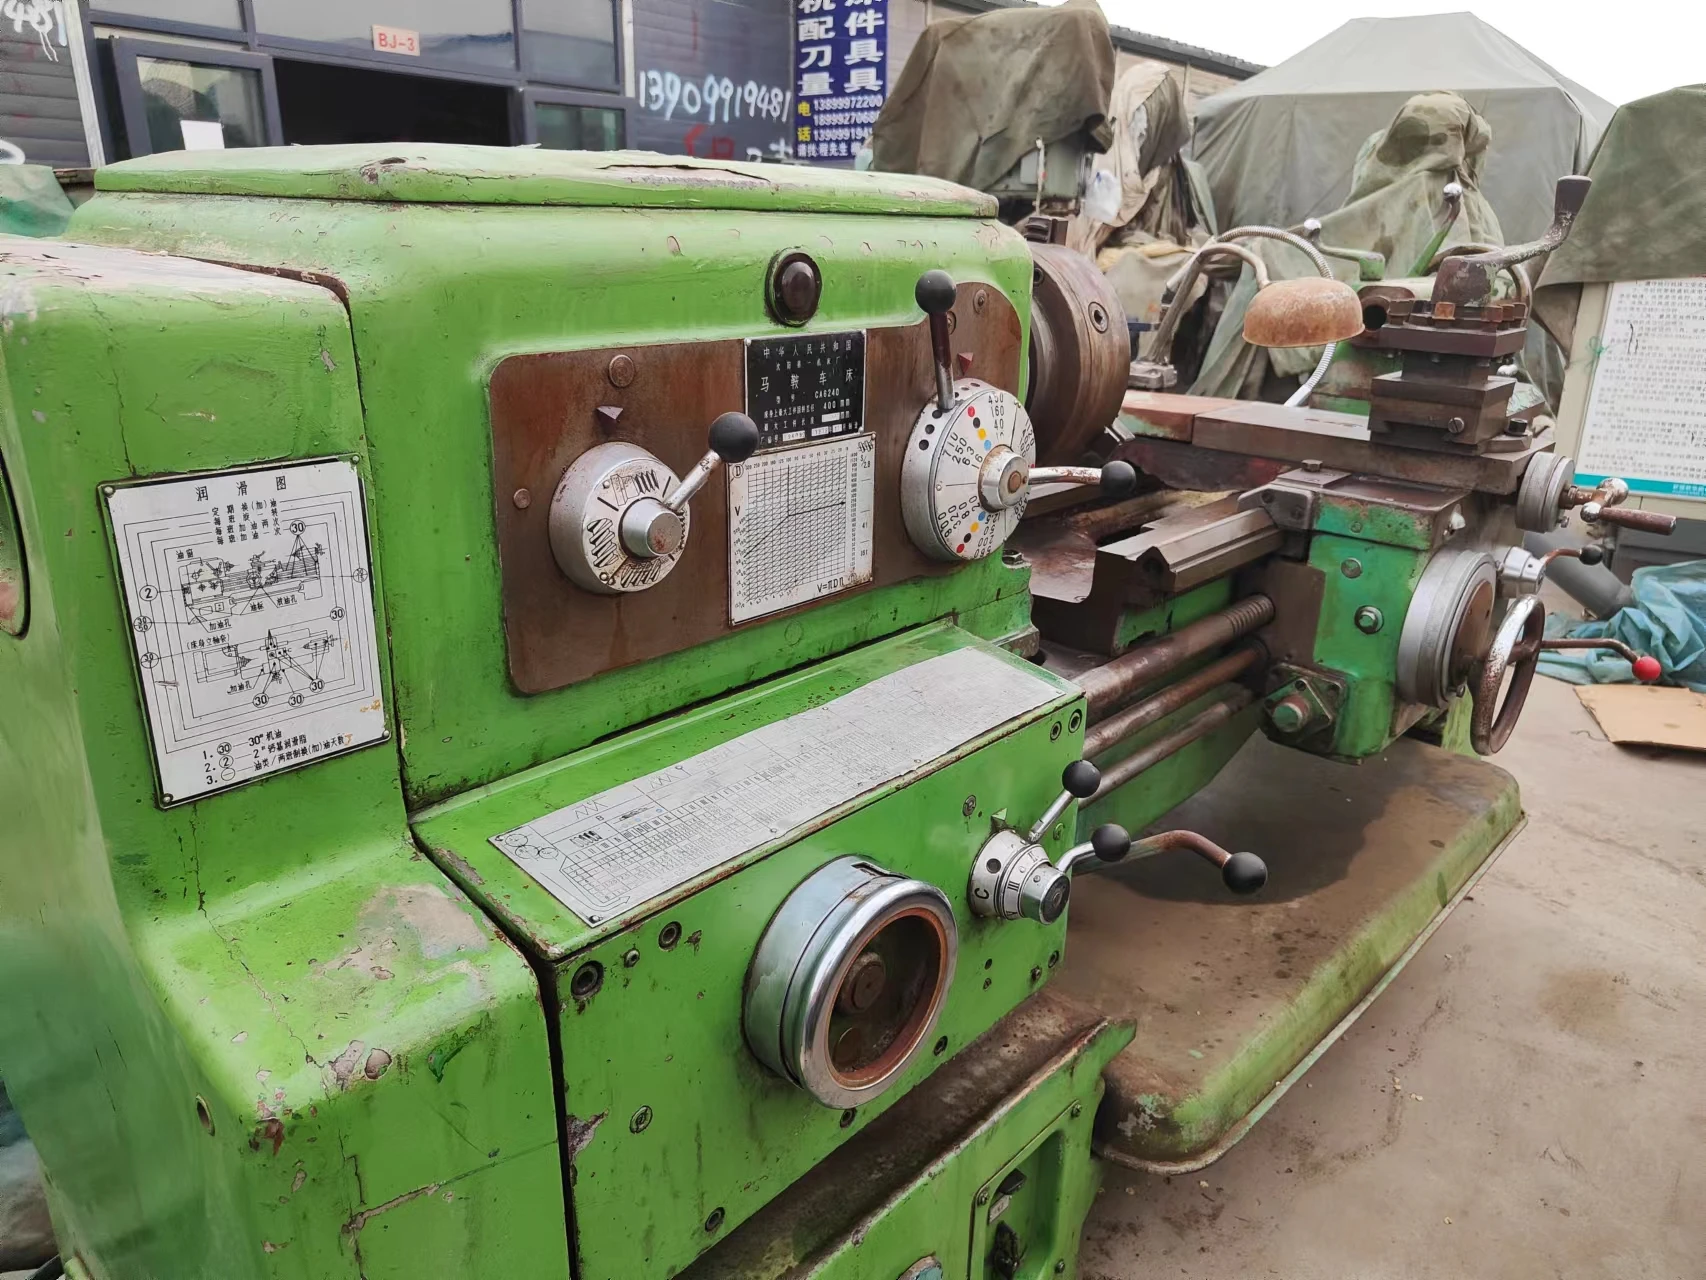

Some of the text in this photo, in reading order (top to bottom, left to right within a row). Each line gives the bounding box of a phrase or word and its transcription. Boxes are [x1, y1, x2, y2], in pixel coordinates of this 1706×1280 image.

[797, 9, 885, 42] 配件
[378, 32, 415, 52] BJ-3
[798, 39, 884, 69] 刀具
[797, 67, 884, 96] 量具
[639, 69, 792, 123] 13909919481
[763, 340, 852, 359] 中华人民共和国
[760, 368, 854, 393] 马鞍车床
[814, 388, 840, 399] CA6240
[823, 400, 836, 410] 400
[991, 405, 1005, 417] 160
[994, 418, 1004, 430] 40
[943, 432, 959, 457] 710
[952, 438, 968, 464] 250
[962, 446, 975, 466] 63
[971, 453, 983, 470] 16
[735, 465, 741, 477] D
[195, 475, 287, 502] 润滑图
[969, 495, 981, 512] 20
[735, 506, 741, 517] V
[958, 501, 970, 520] 80
[948, 505, 962, 530] 320
[291, 523, 305, 534] 30
[938, 511, 952, 538] 900
[144, 587, 153, 599] 2
[331, 608, 344, 620] 30
[209, 618, 232, 631] 加油孔
[229, 680, 252, 692] 加油孔
[311, 680, 323, 691] 30
[254, 695, 267, 706] 30
[290, 695, 303, 706] 30
[217, 744, 230, 754] 30
[204, 763, 216, 773] 2.
[205, 776, 218, 785] 3.
[1007, 880, 1020, 892] III
[974, 887, 990, 900] C
